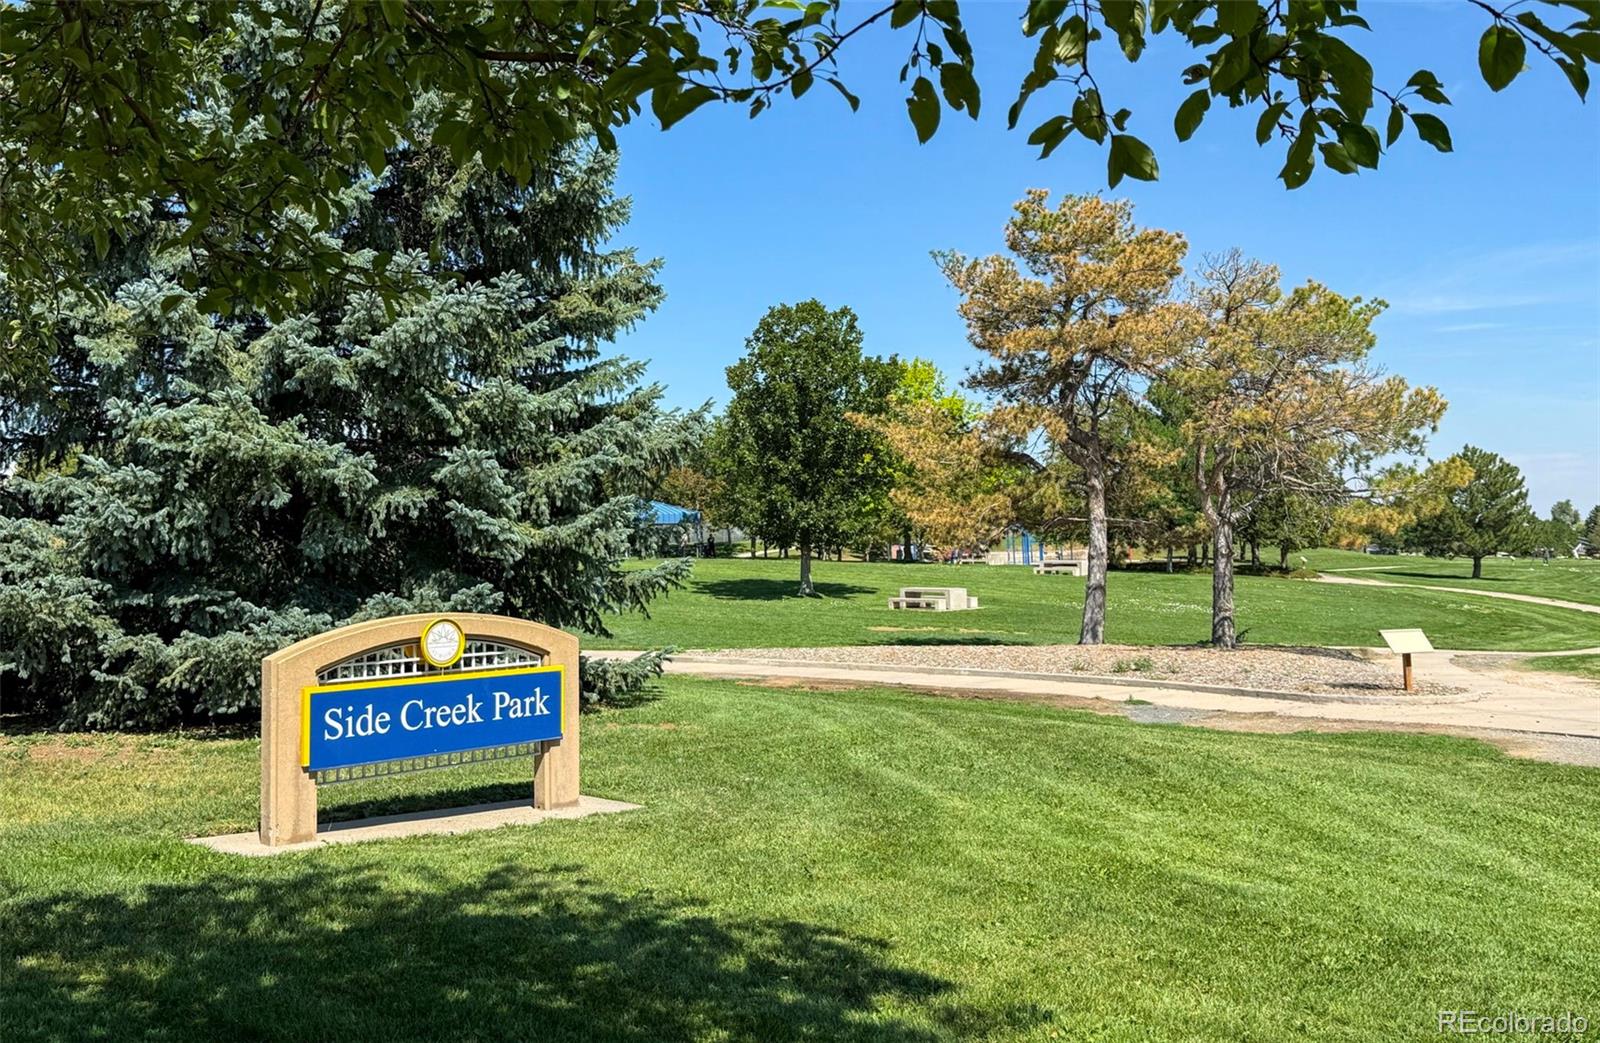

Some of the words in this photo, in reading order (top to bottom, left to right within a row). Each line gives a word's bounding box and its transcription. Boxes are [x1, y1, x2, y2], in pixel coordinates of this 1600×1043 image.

[324, 704, 391, 741] Side
[400, 693, 484, 732] Creek
[492, 687, 551, 721] Park
